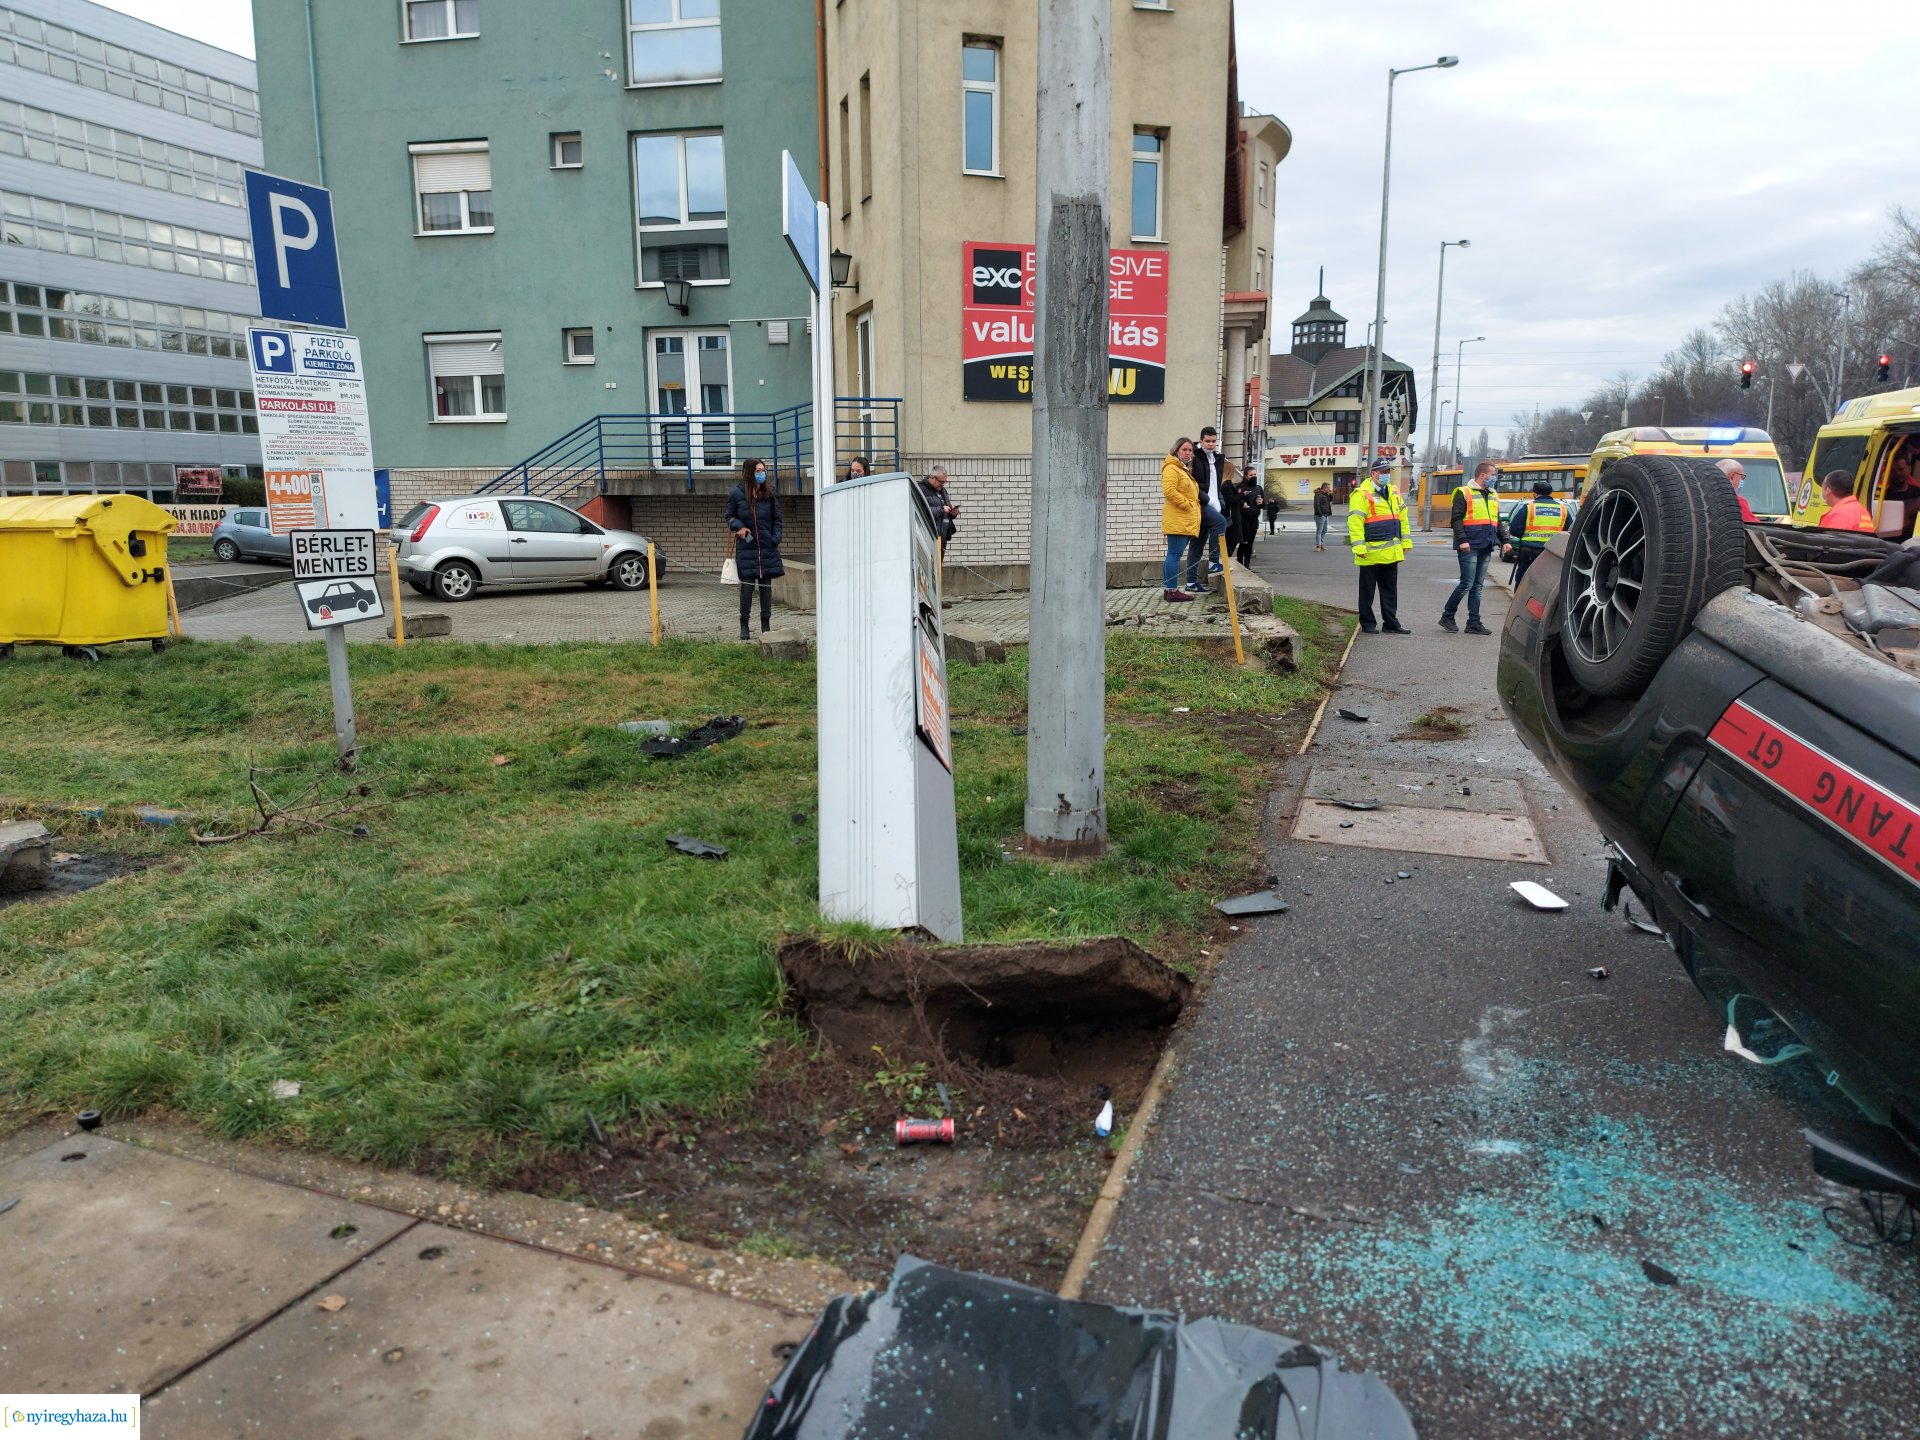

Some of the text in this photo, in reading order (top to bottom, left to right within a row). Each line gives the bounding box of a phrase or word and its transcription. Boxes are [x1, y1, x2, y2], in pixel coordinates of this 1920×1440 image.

[269, 191, 319, 289] P
[972, 266, 1022, 288] exc
[261, 335, 285, 367] P
[304, 348, 352, 361] PARKOLÓ
[305, 359, 355, 371] KIEMELT ZÓNA
[260, 400, 317, 411] PARKOLÁSI
[319, 401, 336, 413] DÍJ:
[1302, 446, 1347, 457] CUTLER
[1309, 457, 1336, 466] GYM
[269, 474, 310, 495] 4400
[190, 507, 227, 521] KIADÓ
[295, 533, 369, 554] BÉRLET-
[296, 556, 368, 575] MENTES
[1747, 731, 1920, 872] TANG GT
